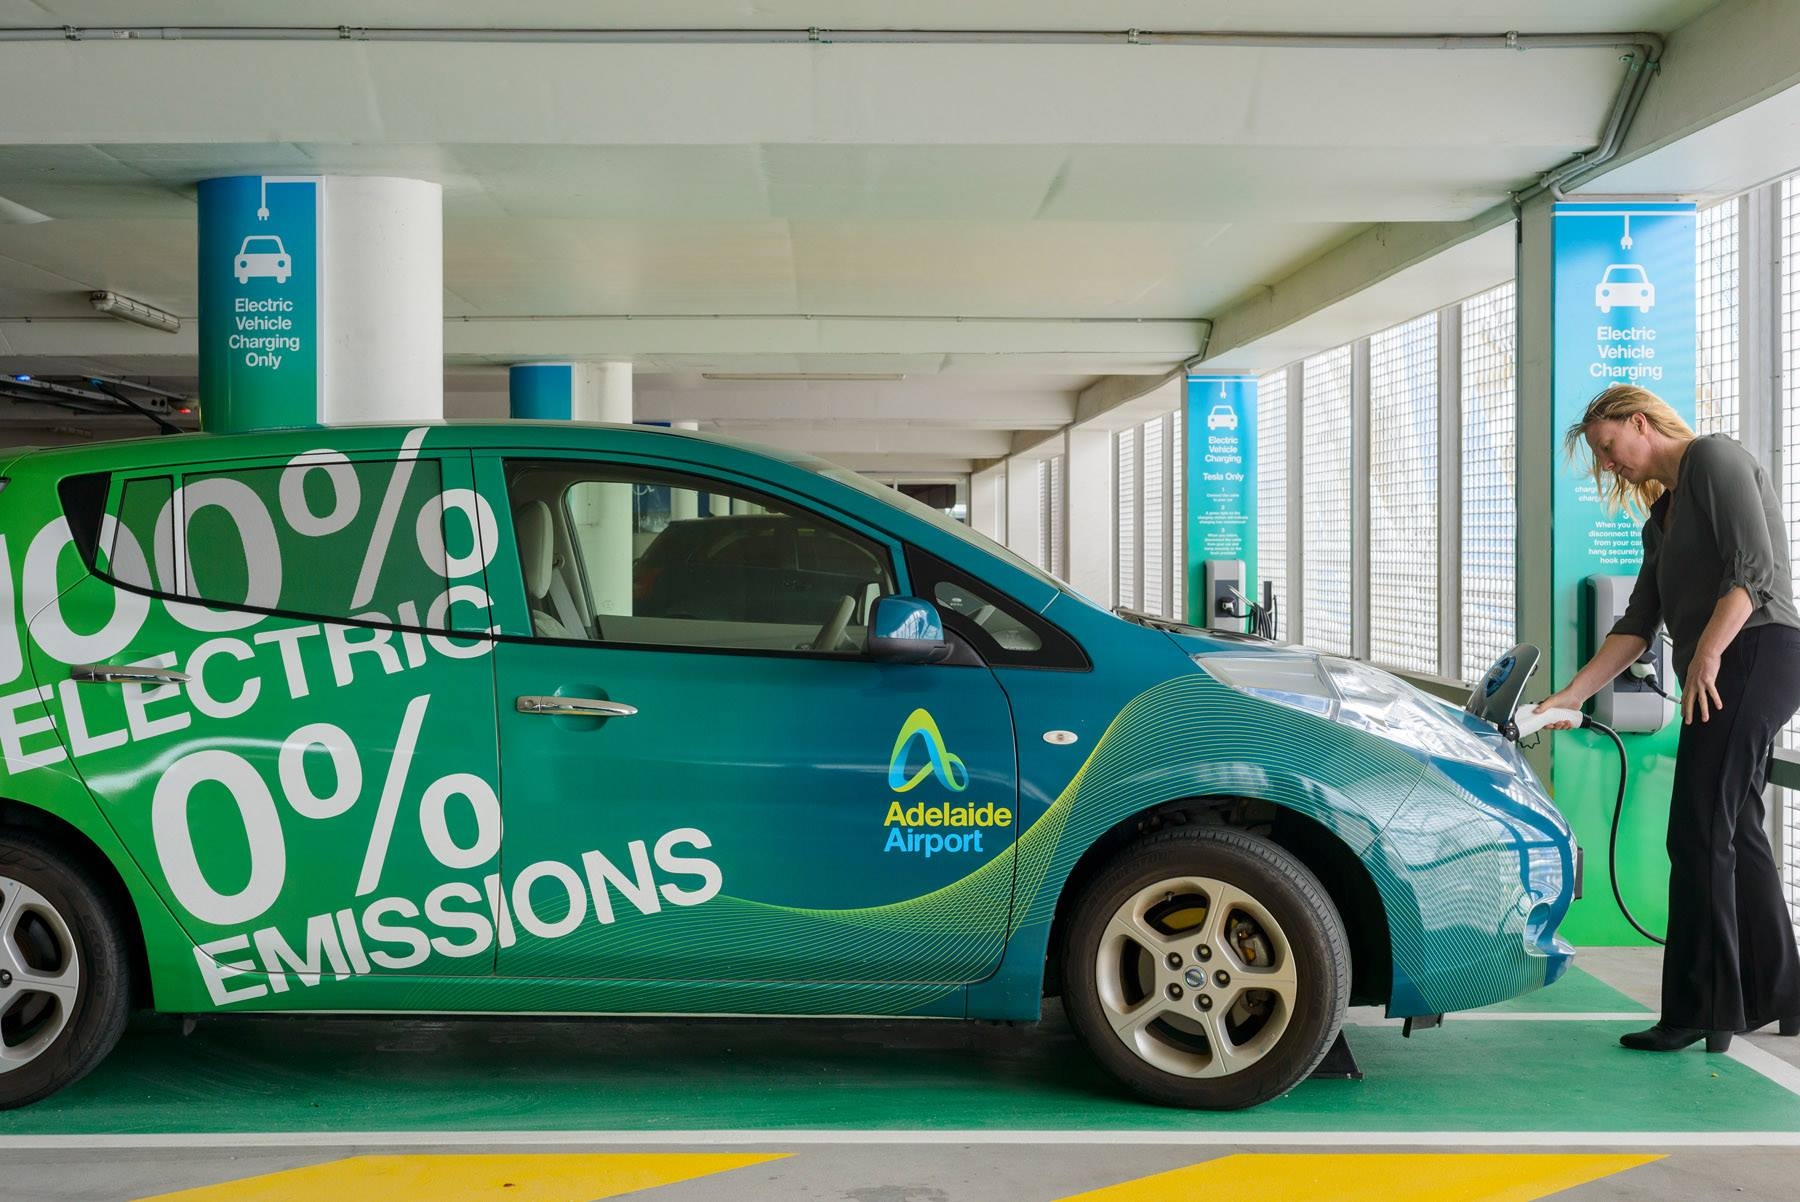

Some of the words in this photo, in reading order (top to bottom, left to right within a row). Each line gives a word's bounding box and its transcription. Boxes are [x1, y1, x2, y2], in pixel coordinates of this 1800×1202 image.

[235, 297, 293, 313] Electric
[235, 315, 292, 331] Vehicle
[1597, 326, 1657, 341] Electric
[228, 334, 300, 351] Charging
[1597, 344, 1656, 359] Vehicle
[245, 352, 282, 370] Only
[1589, 362, 1663, 380] Charging
[1208, 435, 1239, 445] Electric
[1208, 445, 1239, 454] Vehicle
[1204, 454, 1242, 464] Charging
[1203, 472, 1224, 481] Tesla
[1225, 472, 1244, 482] Only
[1617, 522, 1631, 530] you
[0, 585, 501, 775] ELECTRIC
[151, 694, 503, 925] 0%
[884, 801, 1012, 827] Adelaide
[884, 827, 983, 858] Airport
[193, 828, 723, 1006] EMISSIONS
